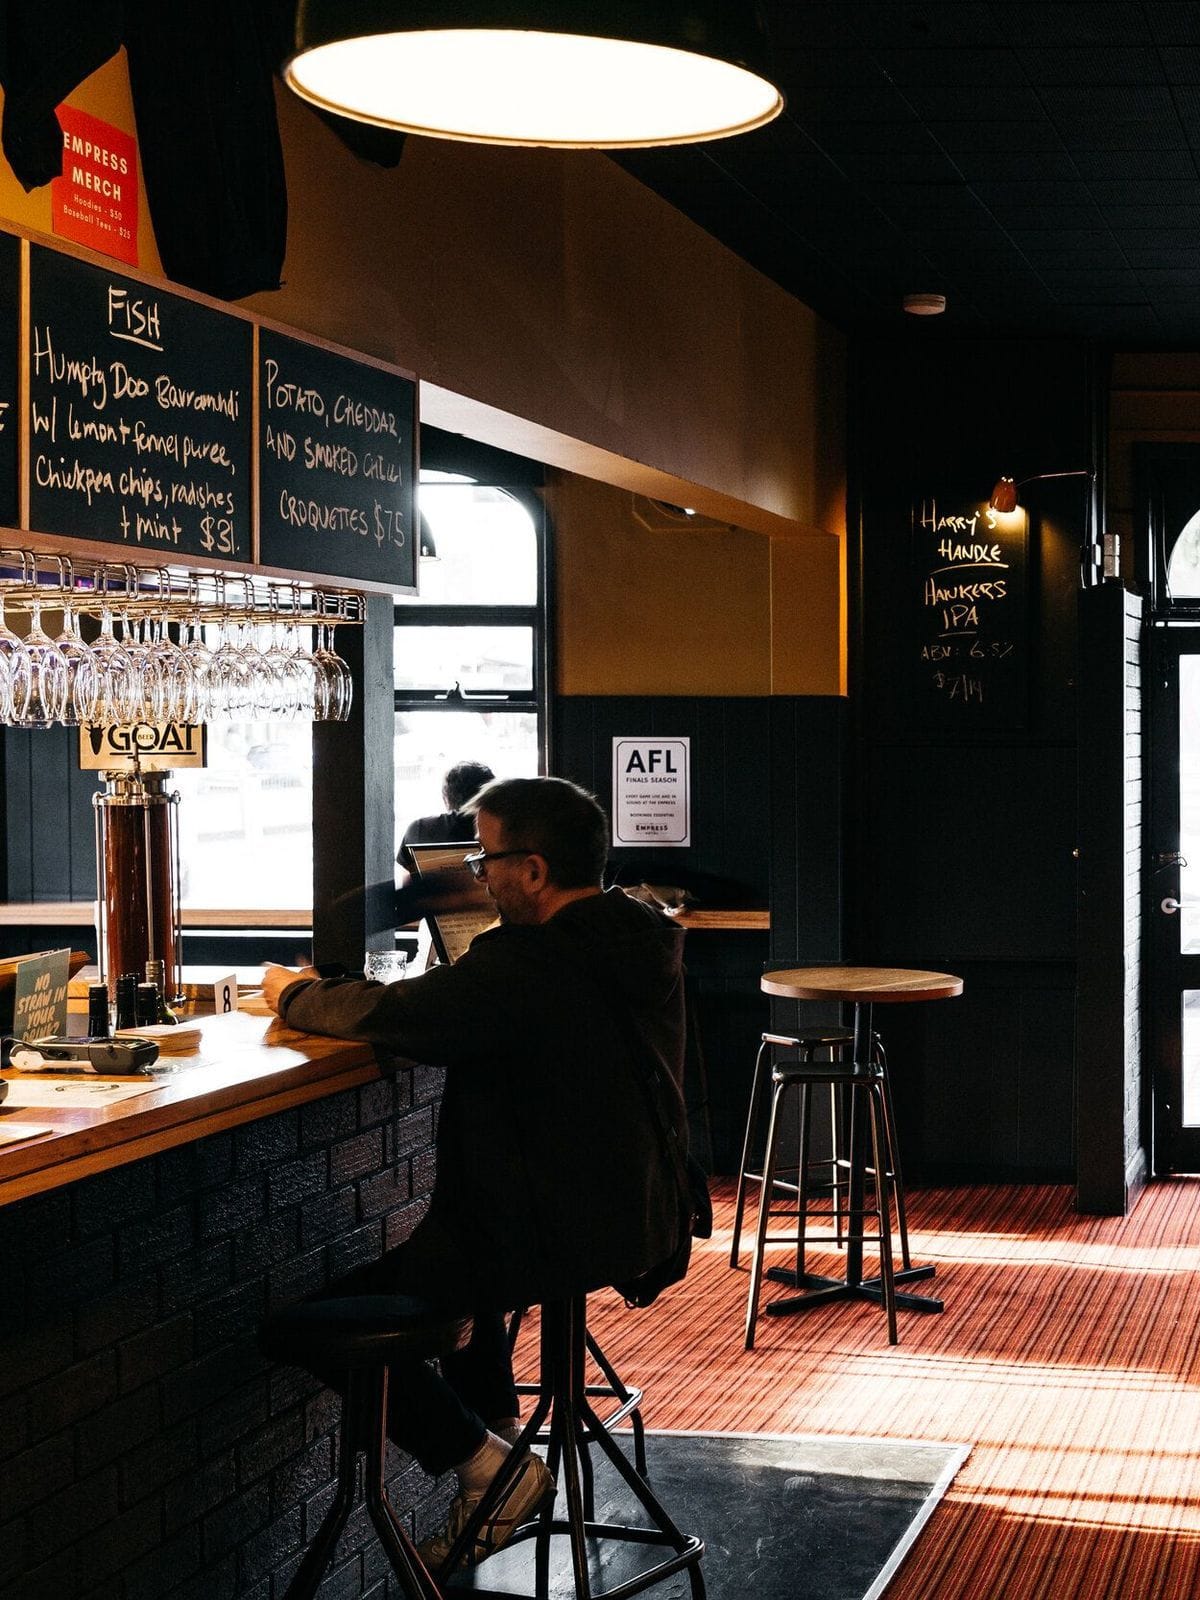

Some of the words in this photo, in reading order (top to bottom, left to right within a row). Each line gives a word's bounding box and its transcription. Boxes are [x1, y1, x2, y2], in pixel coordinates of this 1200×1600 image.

[63, 131, 128, 175] EMPRESS
[72, 166, 121, 201] MERCH
[74, 194, 102, 213] Hoodies
[63, 204, 94, 223] Baseball
[96, 217, 112, 231] Tees
[119, 227, 131, 240] $25
[108, 285, 161, 340] FISH
[33, 326, 107, 410] Humpty
[110, 361, 150, 400] Doo
[68, 402, 118, 443] lemon
[132, 420, 180, 462] fennel
[266, 424, 296, 462] AND
[304, 436, 358, 477] SMOKED
[279, 489, 369, 536] CROQUETTES
[937, 538, 1002, 563] HANDLE
[925, 577, 1008, 606] HAWKERS
[943, 604, 979, 630] IPA
[107, 722, 199, 752] GOAT
[626, 750, 677, 773] AFL
[34, 972, 51, 993] NO
[16, 989, 53, 1015] STRAW
[53, 985, 67, 1004] IN
[222, 985, 232, 1013] 8
[26, 1005, 55, 1030] YOUR
